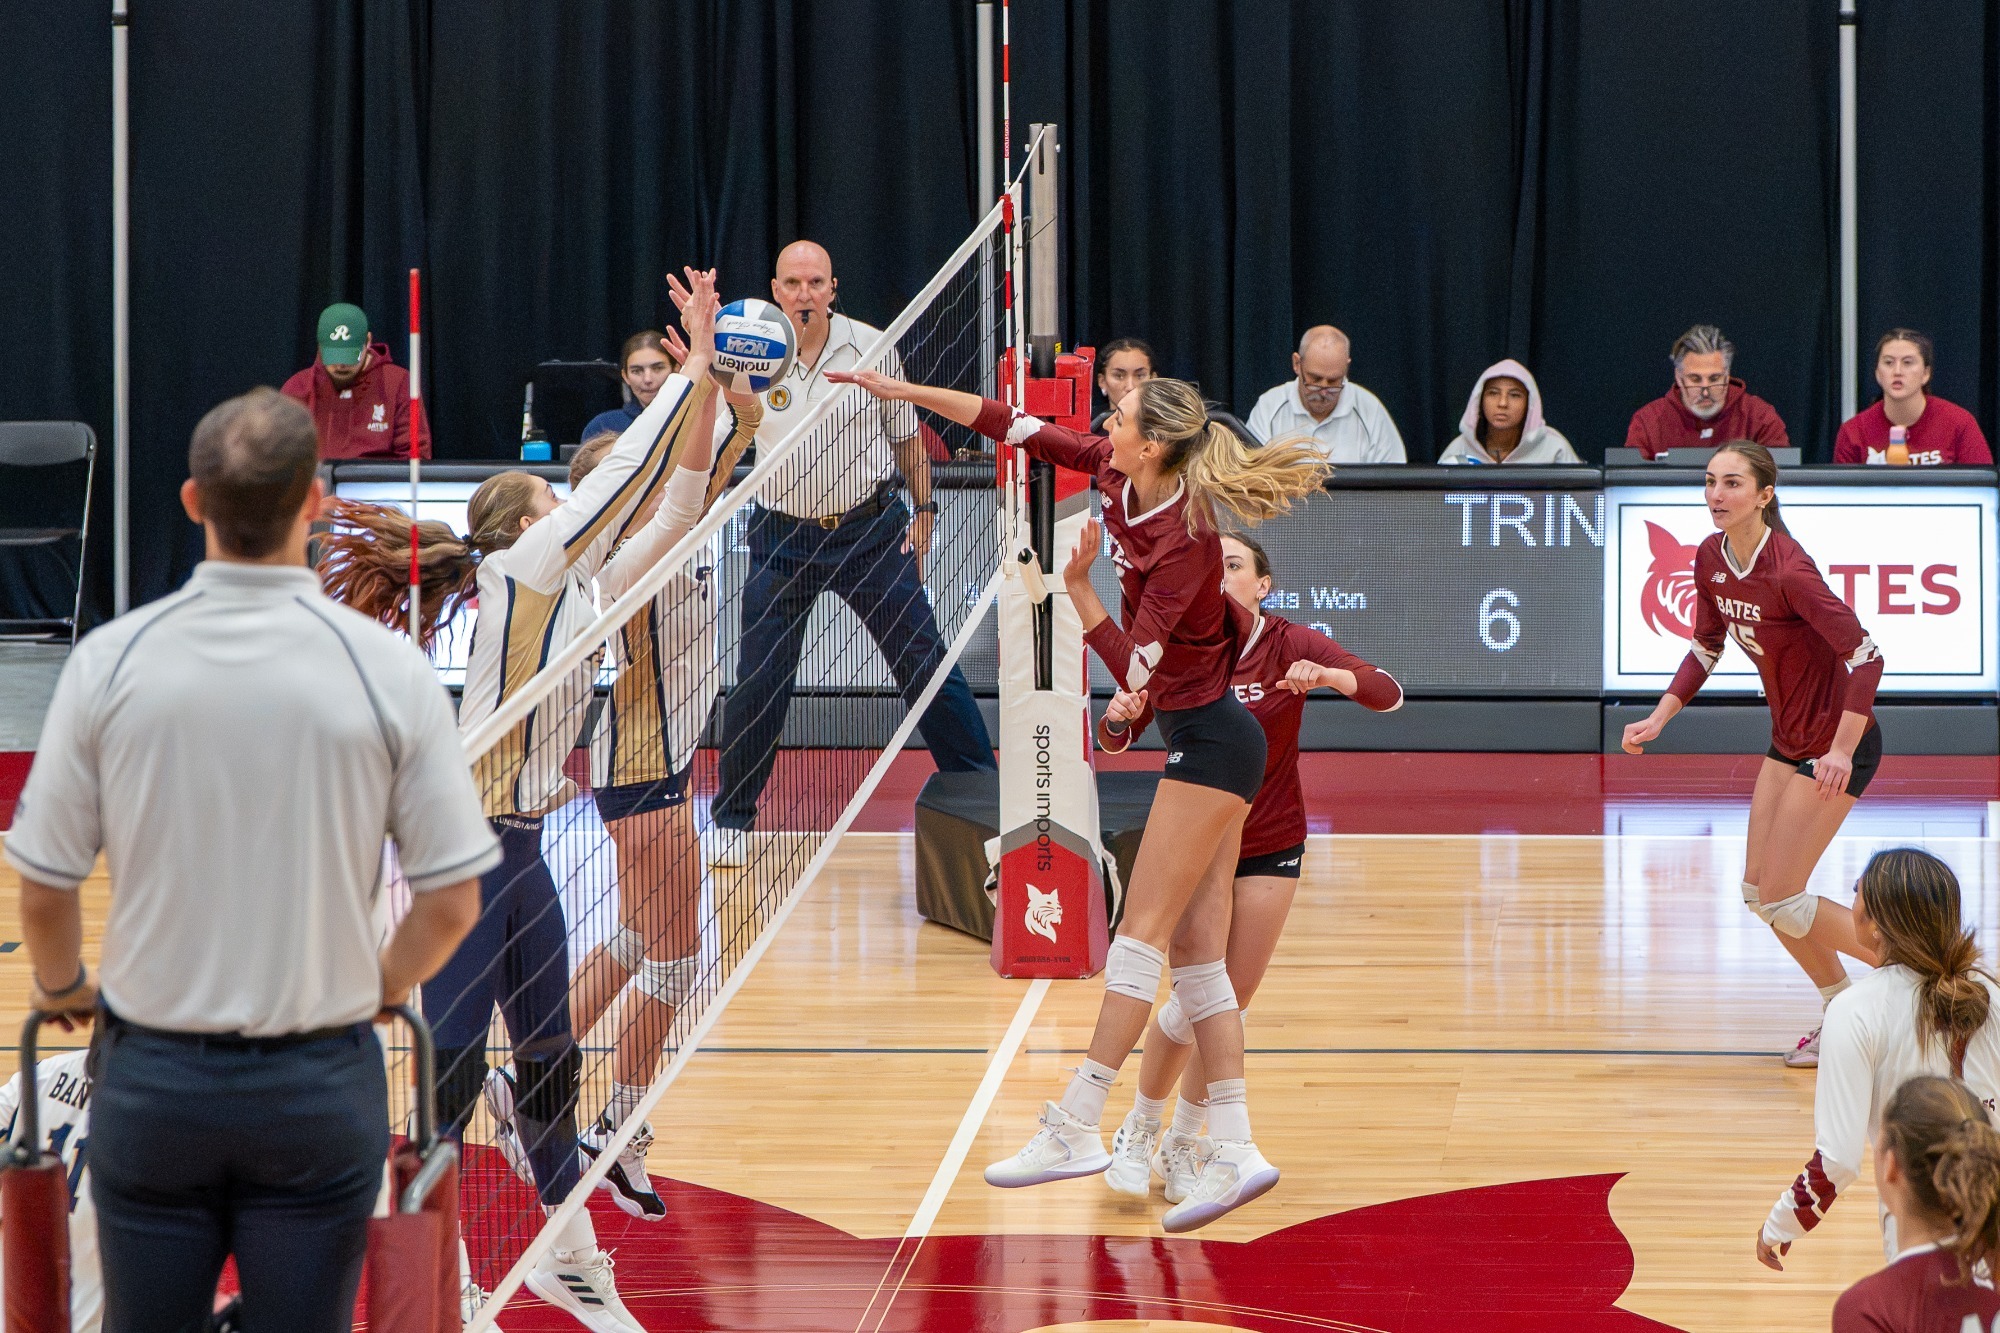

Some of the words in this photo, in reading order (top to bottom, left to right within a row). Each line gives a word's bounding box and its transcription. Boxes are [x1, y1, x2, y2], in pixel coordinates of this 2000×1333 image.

[726, 336, 770, 357] NCAA
[718, 354, 770, 373] molten
[1907, 450, 1943, 466] TES
[1444, 493, 1605, 547] TRIN
[1310, 586, 1367, 609] Won
[1828, 563, 1961, 616] TES
[1479, 587, 1521, 652] 6
[1715, 594, 1761, 622] BATES
[1231, 682, 1265, 704] ES
[1032, 724, 1053, 789] sports
[1033, 792, 1054, 872] imports
[49, 1072, 88, 1110] BAN
